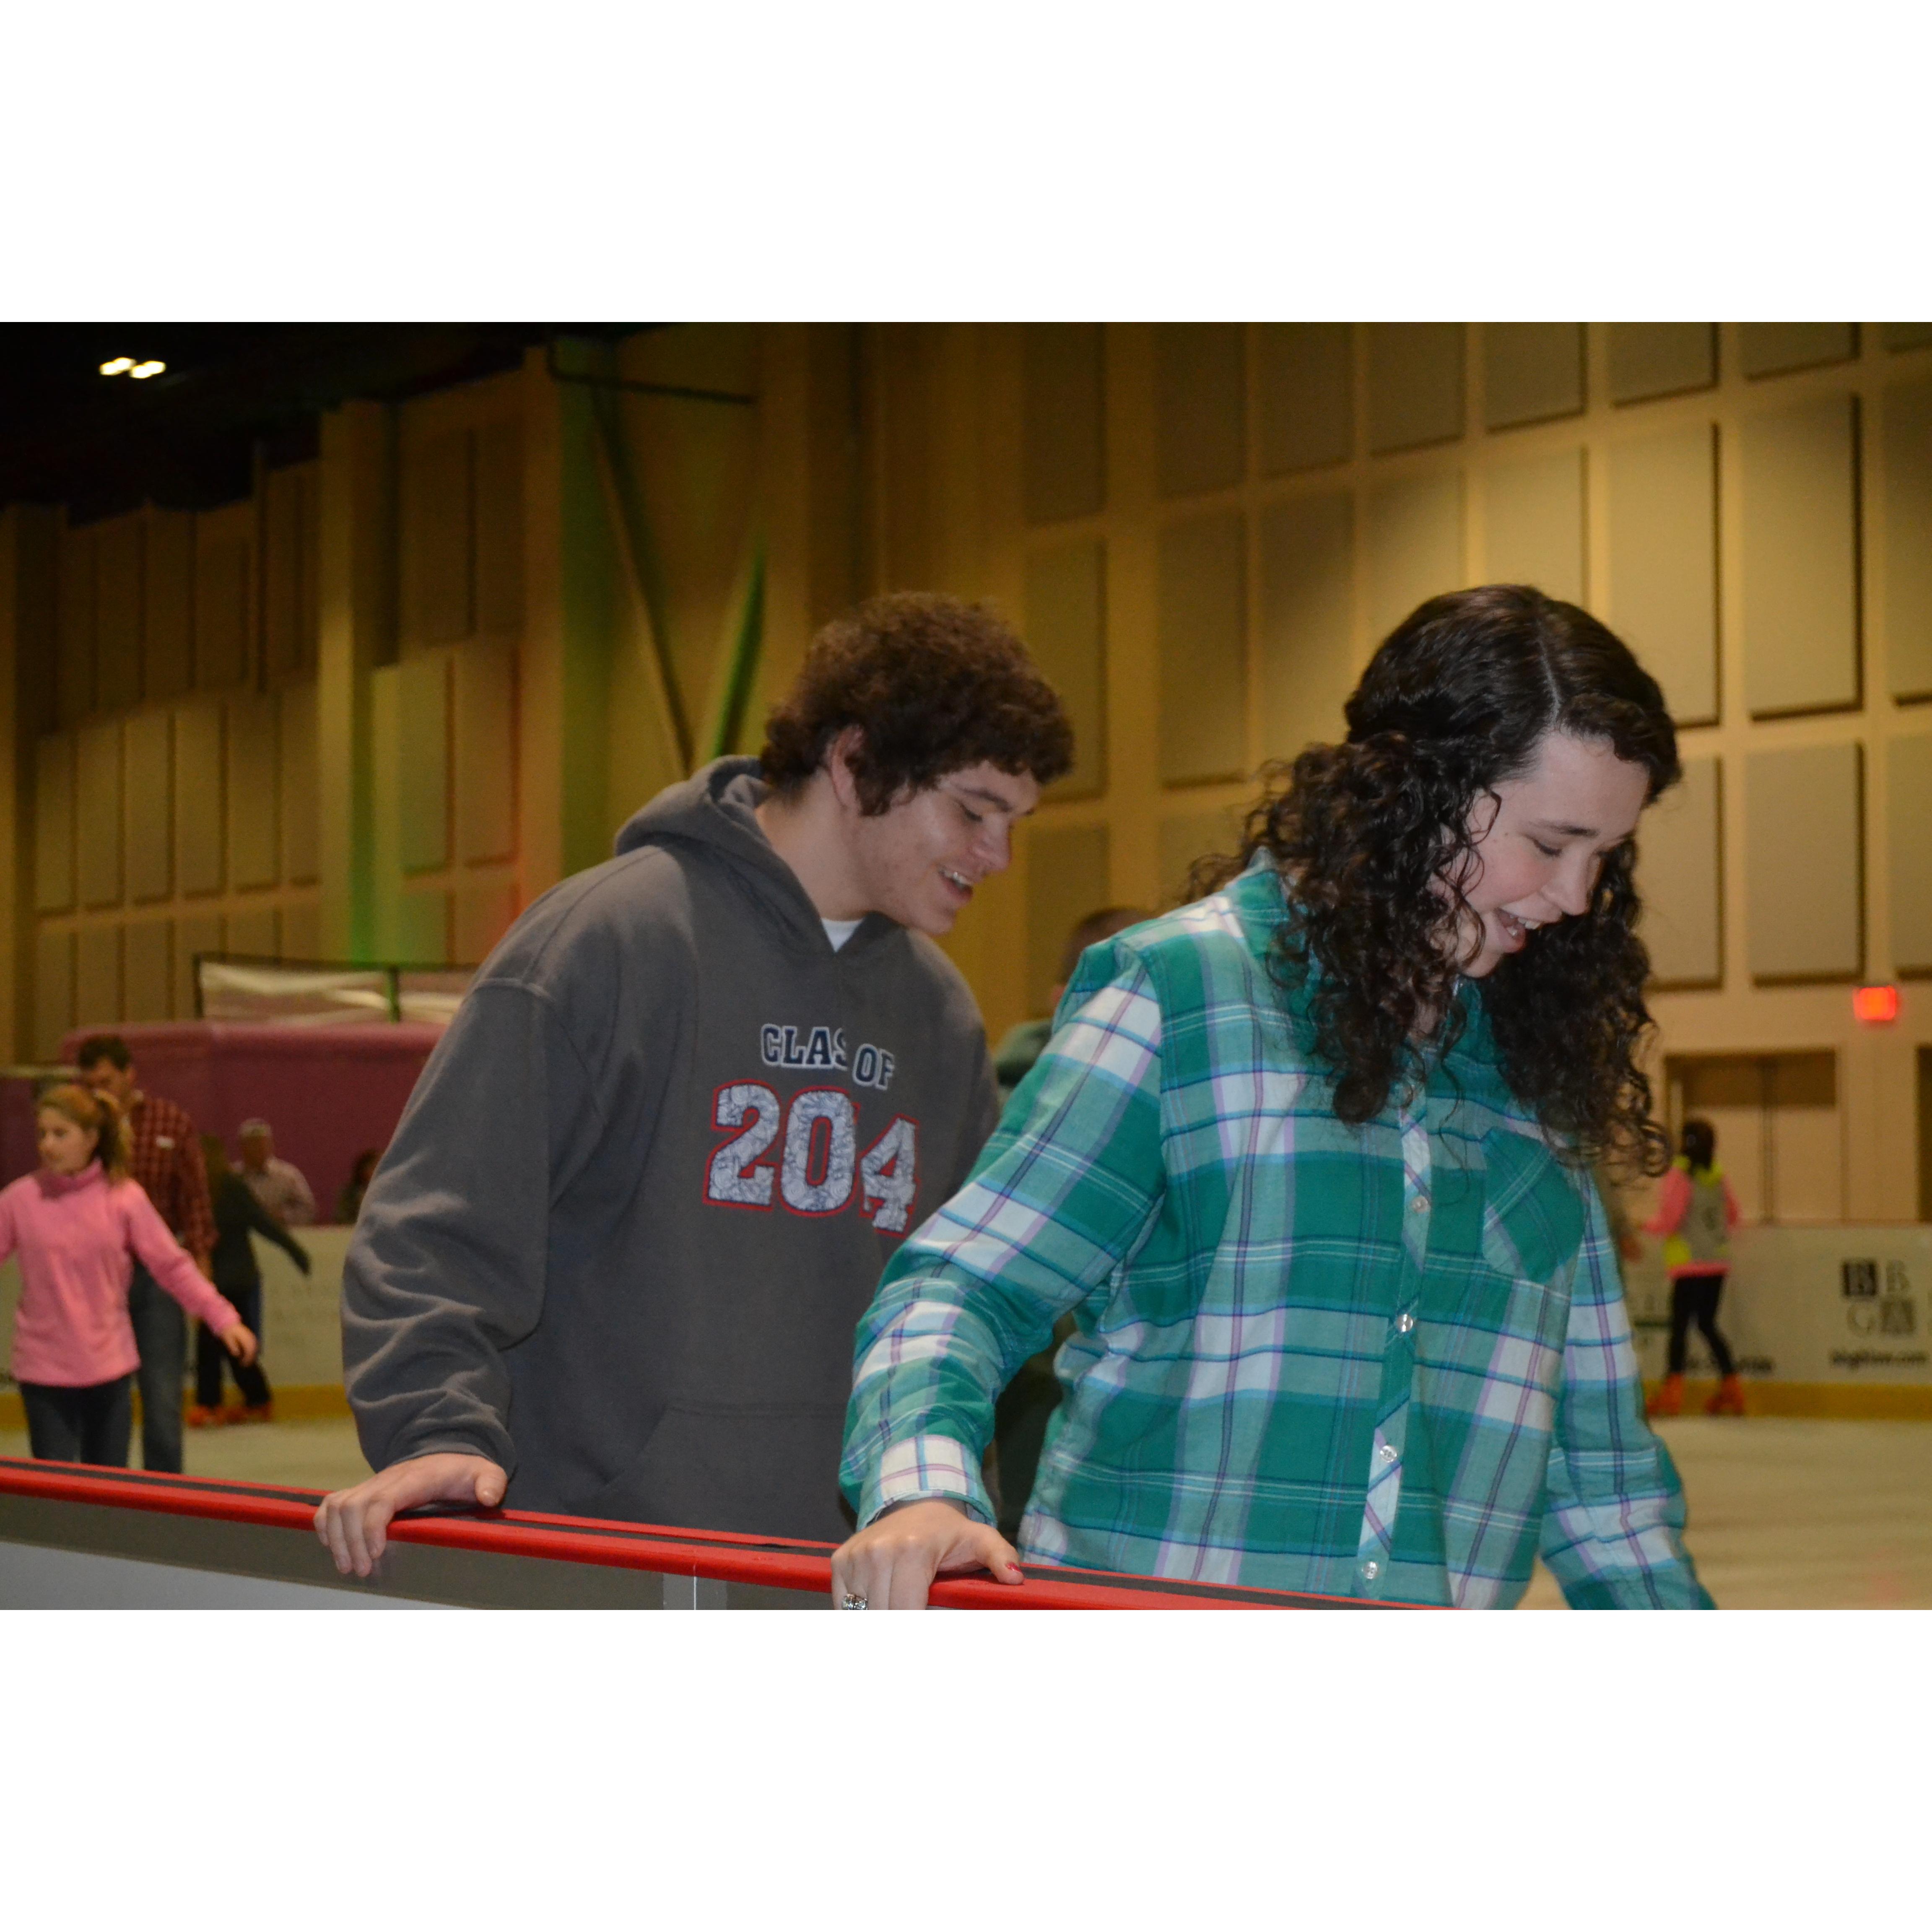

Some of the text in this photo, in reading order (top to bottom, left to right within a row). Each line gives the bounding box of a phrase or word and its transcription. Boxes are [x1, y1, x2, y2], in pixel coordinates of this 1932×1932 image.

[761, 1023, 895, 1091] CLAS OF
[702, 1078, 920, 1239] 204
